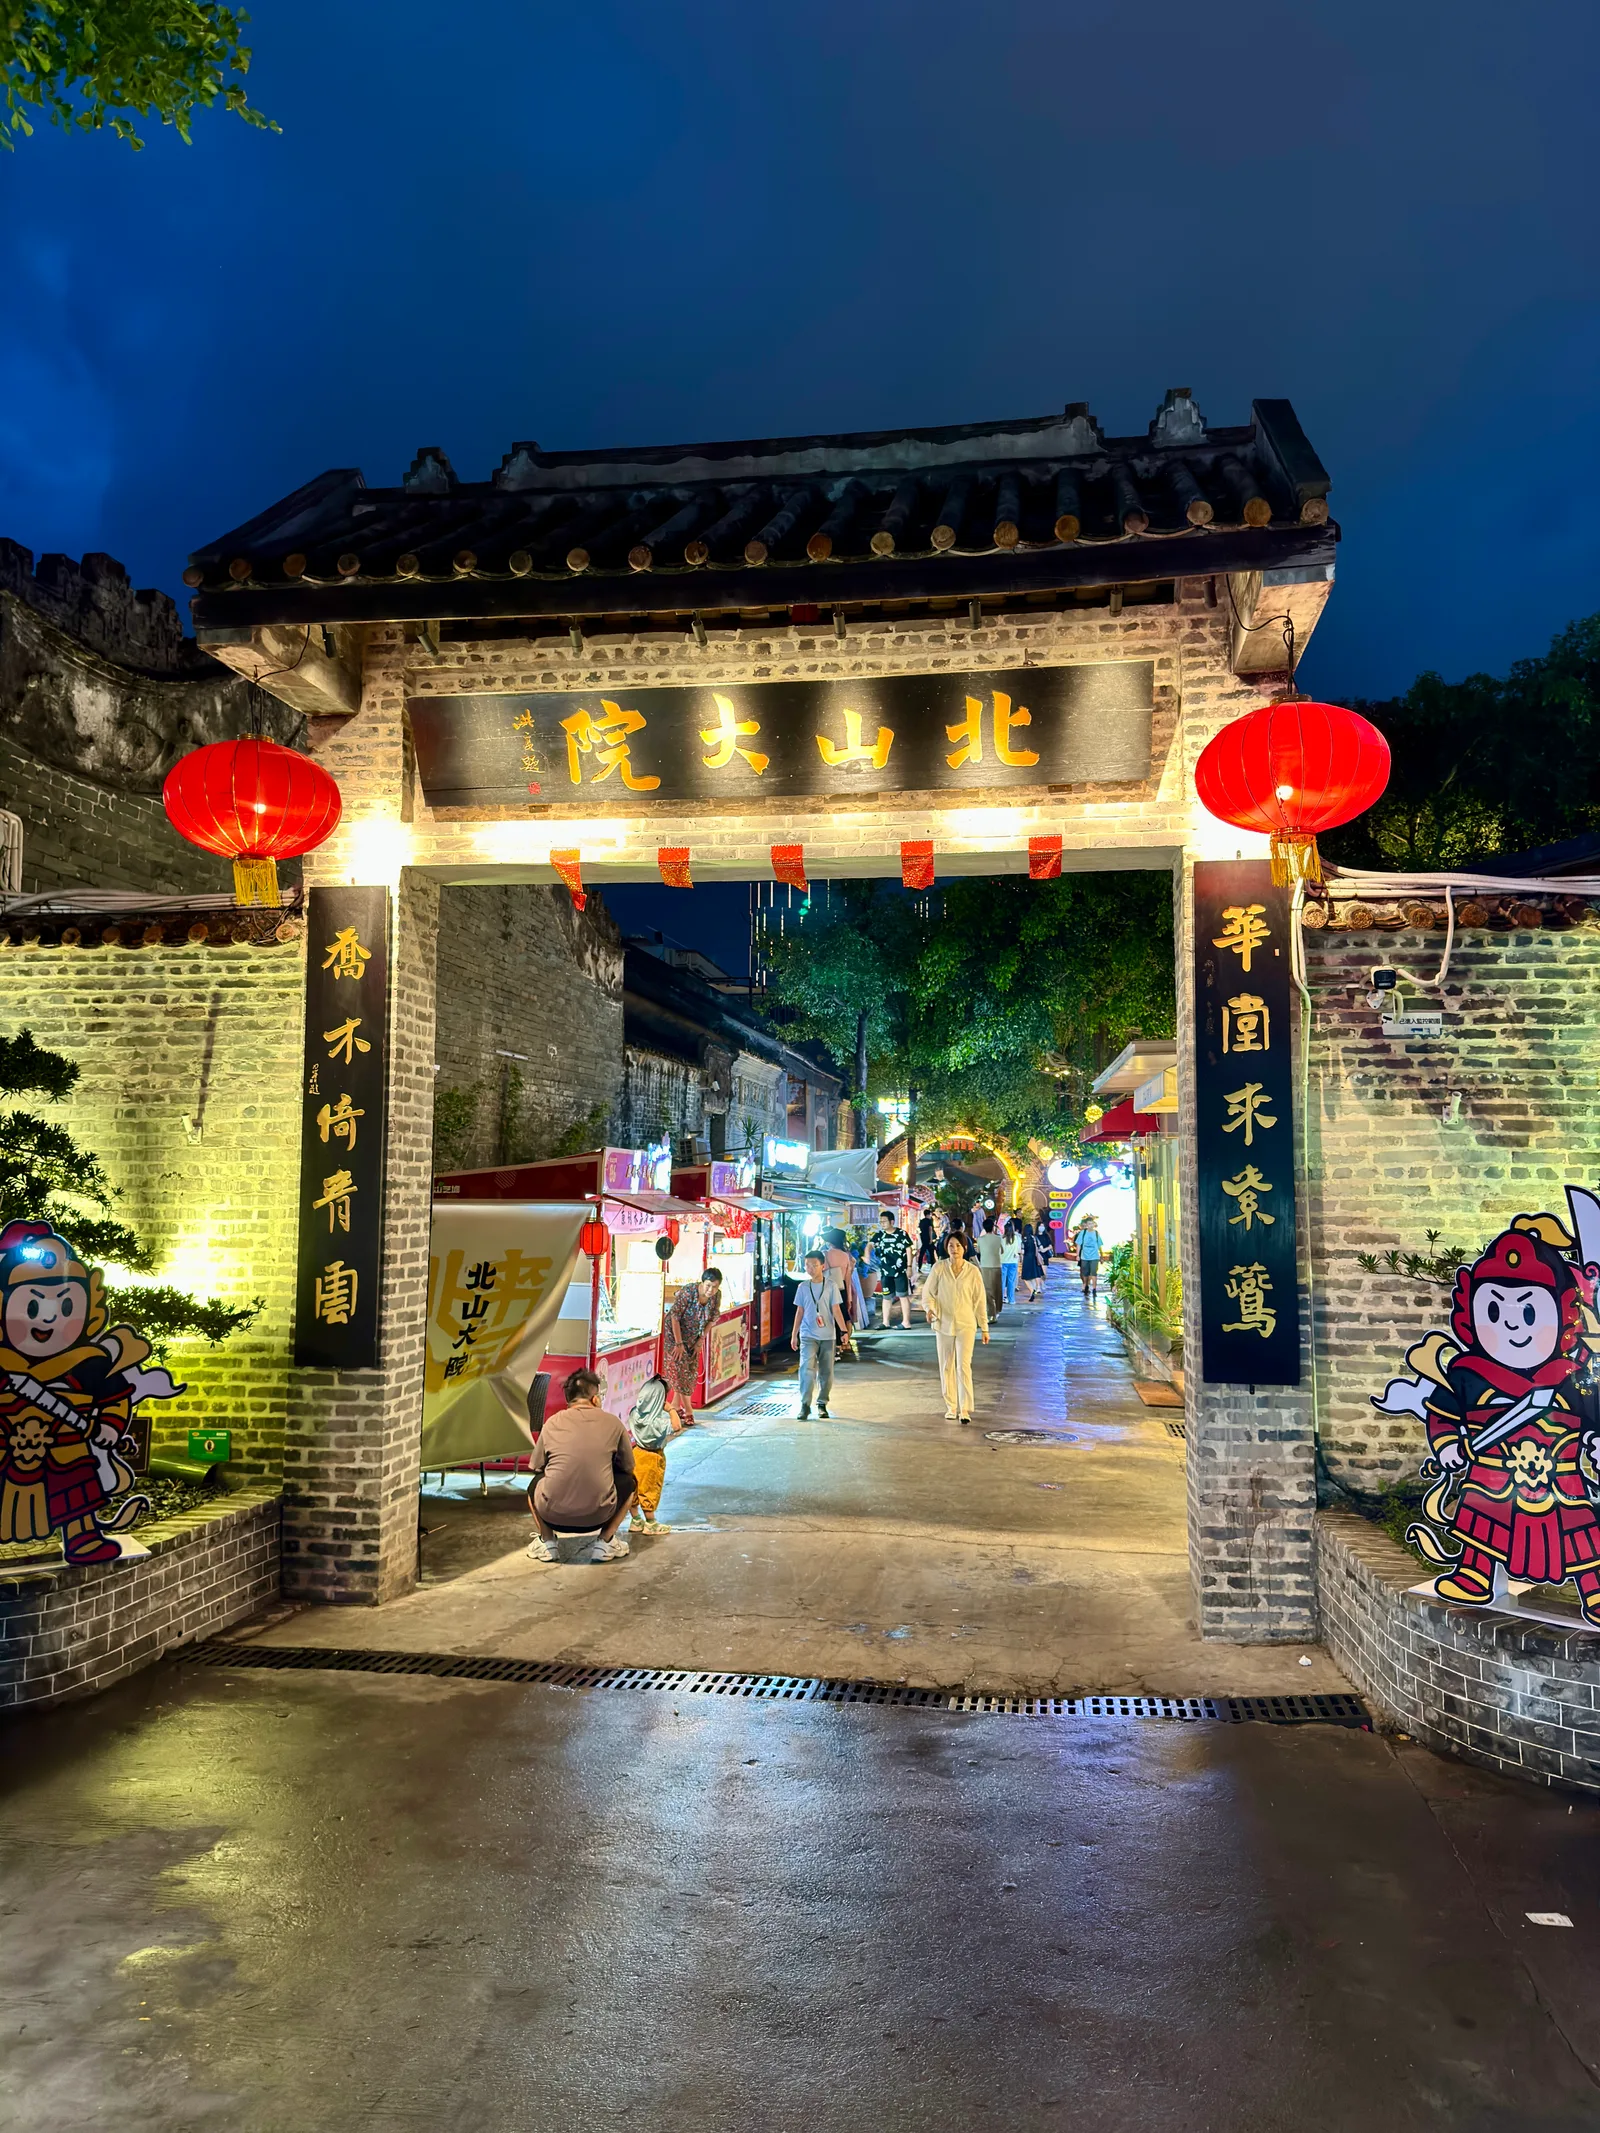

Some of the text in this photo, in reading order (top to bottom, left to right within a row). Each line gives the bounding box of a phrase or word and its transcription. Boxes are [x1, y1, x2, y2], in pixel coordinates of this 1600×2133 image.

[559, 690, 1040, 792] 北山大院
[313, 925, 372, 1325] 喬木倚青雲
[444, 1261, 497, 1380] 北山大院
